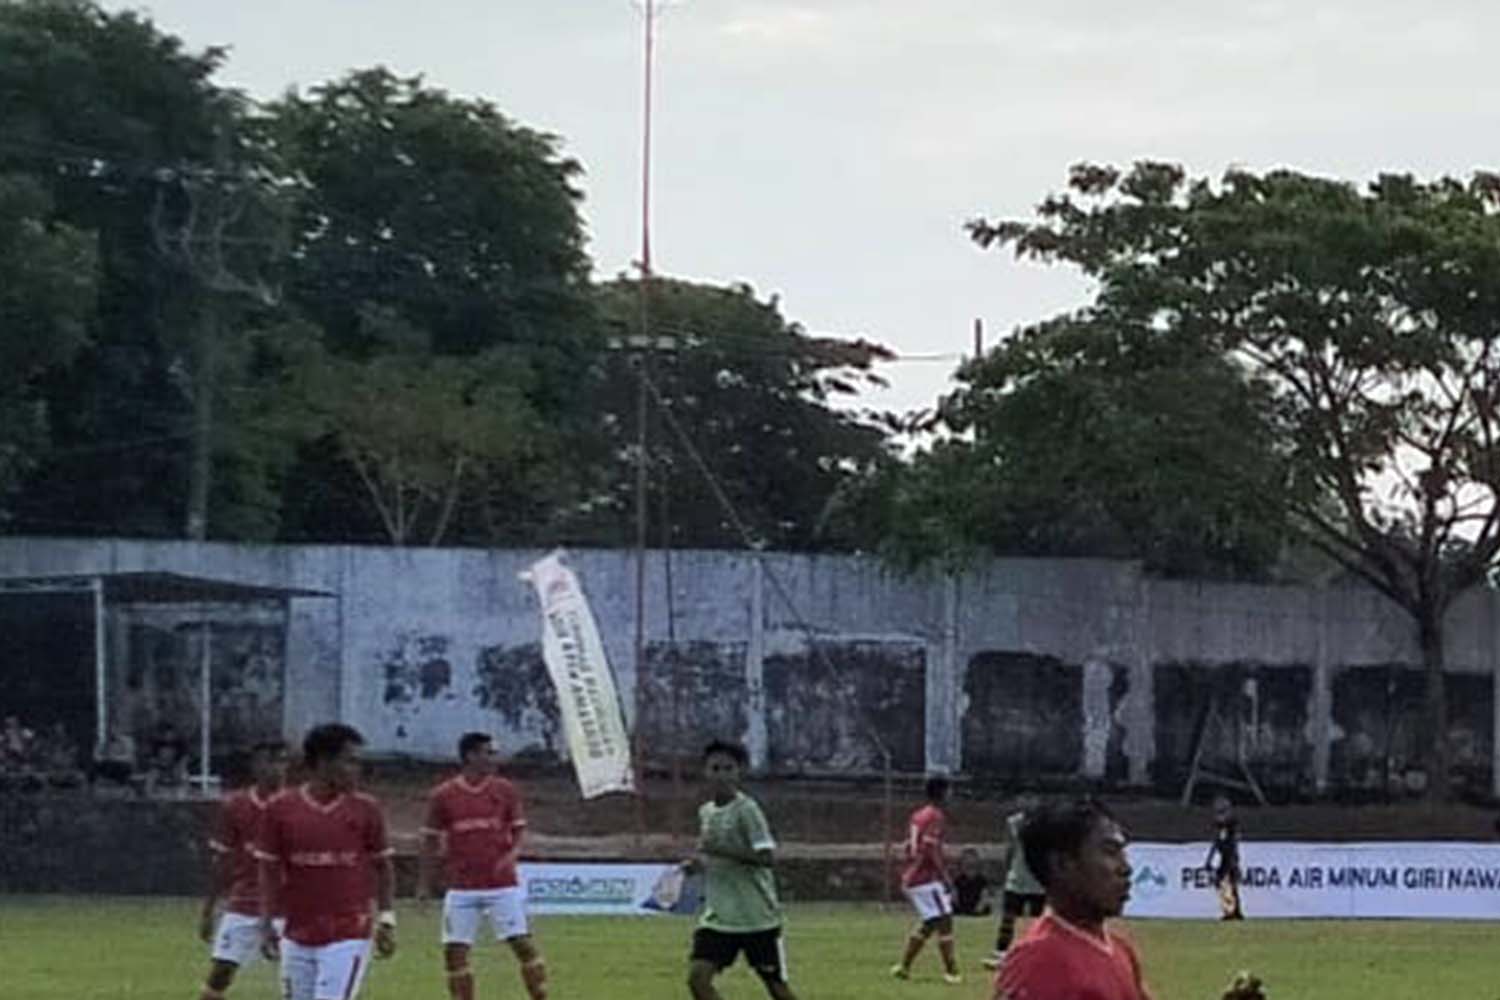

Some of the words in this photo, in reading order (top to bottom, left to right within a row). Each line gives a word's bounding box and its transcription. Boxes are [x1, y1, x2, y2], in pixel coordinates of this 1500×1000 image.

[1181, 867, 1281, 888] PERMDA
[1288, 867, 1323, 888] AIR
[1328, 867, 1397, 888] MINUM
[1404, 867, 1442, 889] GIRI
